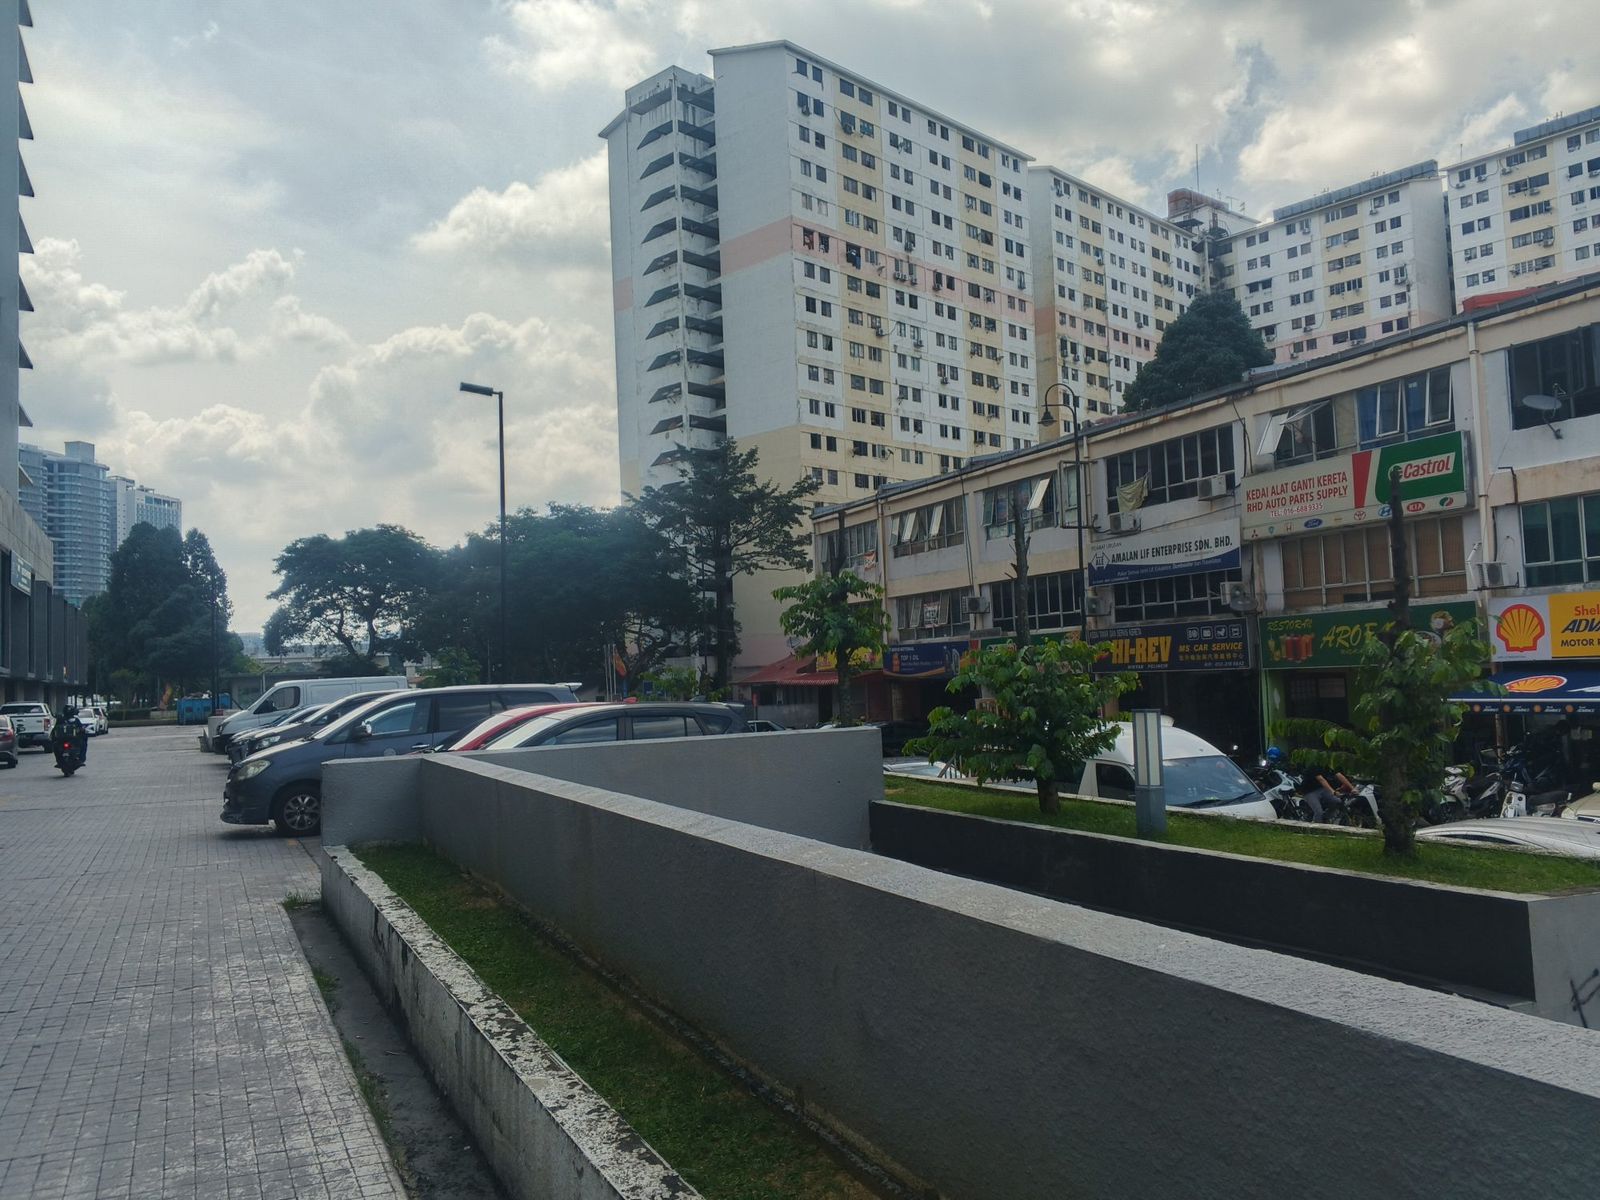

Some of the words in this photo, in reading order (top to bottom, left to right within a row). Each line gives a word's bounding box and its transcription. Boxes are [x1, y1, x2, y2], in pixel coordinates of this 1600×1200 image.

[1404, 455, 1452, 479] Castrol
[1246, 486, 1269, 501] KEDAI
[1270, 480, 1289, 496] ALAT
[1290, 476, 1316, 492] GANTI
[1317, 471, 1348, 487] KERETA
[1247, 501, 1264, 513] RHD
[1265, 496, 1287, 510] AUTO
[1289, 491, 1314, 506] PARTS
[1316, 484, 1348, 500] SUPPLY
[1408, 503, 1424, 511] KIA
[1111, 551, 1139, 564] AMALAN
[1140, 549, 1150, 559] LIF
[1151, 541, 1192, 558] ENTERPRISE
[1194, 539, 1213, 552] SDN.
[1214, 535, 1233, 549] BHD.
[1111, 636, 1172, 665] HI-REV
[1178, 644, 1190, 653] MS
[1193, 643, 1209, 652] CAR
[1211, 641, 1244, 652] SERVICE
[1560, 638, 1595, 648] MOTOR
